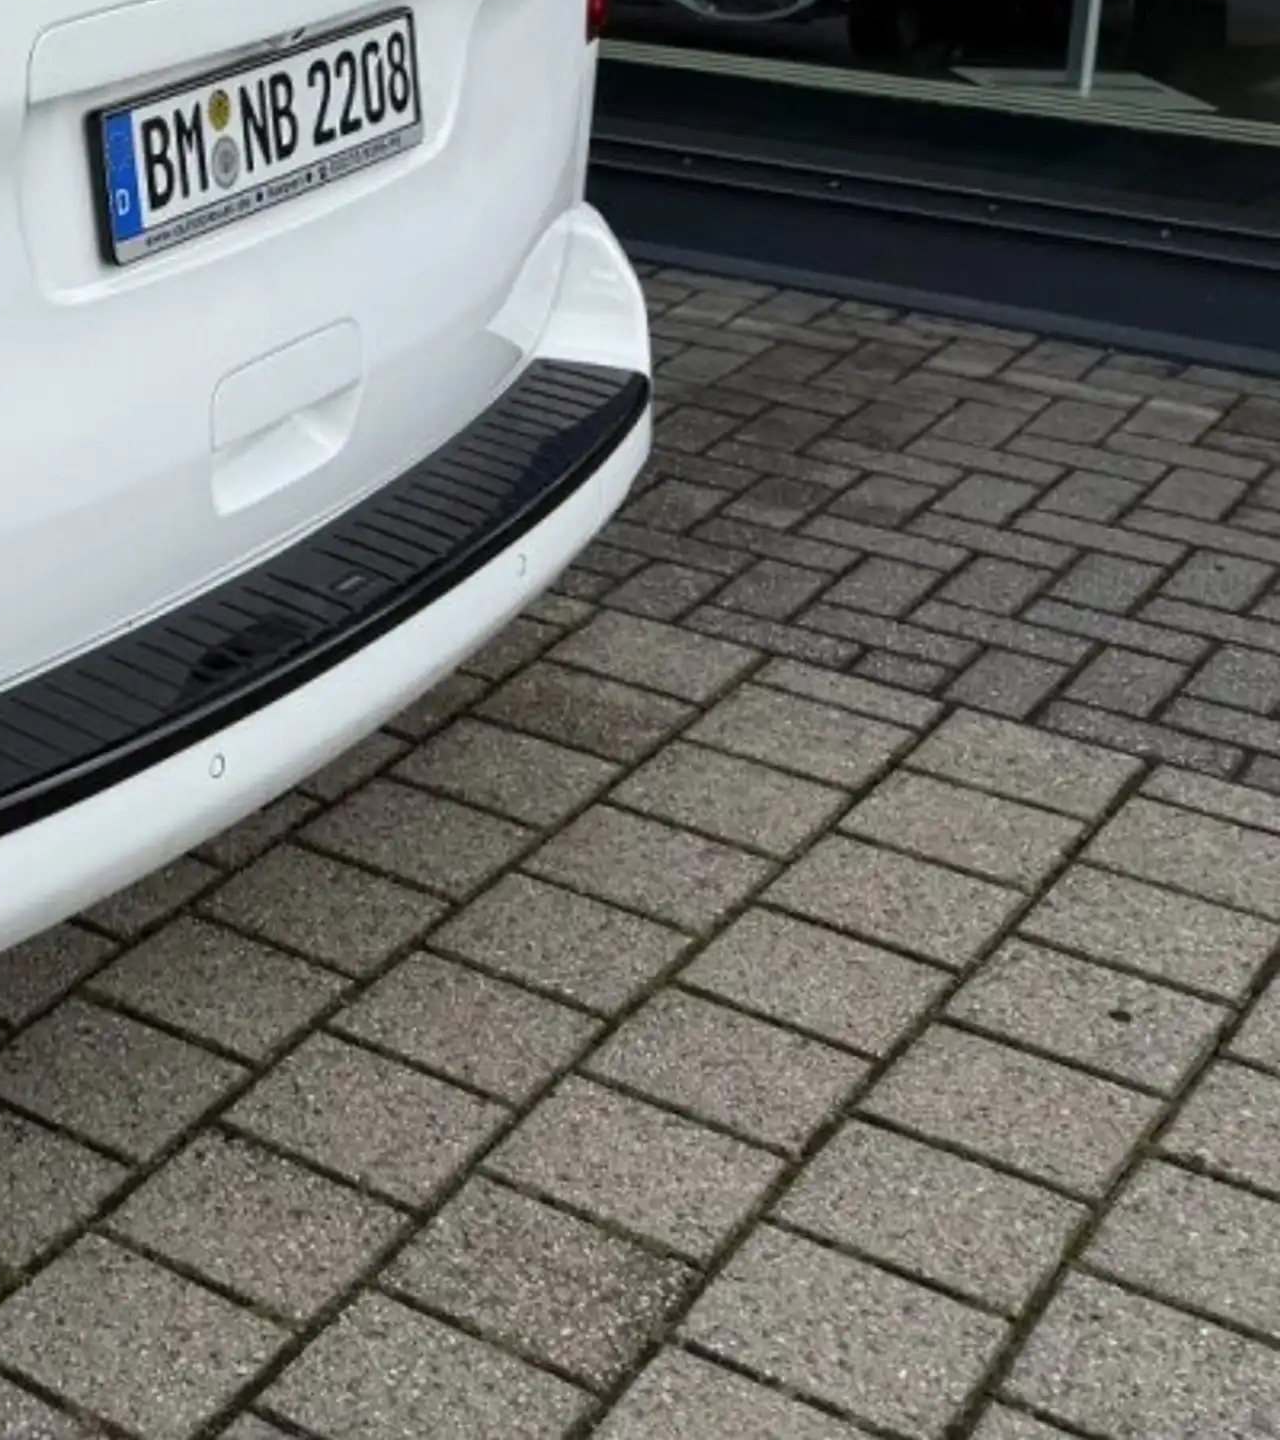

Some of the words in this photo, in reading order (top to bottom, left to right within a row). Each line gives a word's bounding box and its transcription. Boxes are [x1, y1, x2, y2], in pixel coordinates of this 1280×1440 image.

[141, 101, 210, 211] BM
[238, 70, 299, 174] NB
[307, 30, 411, 146] 2208
[116, 189, 131, 216] D
